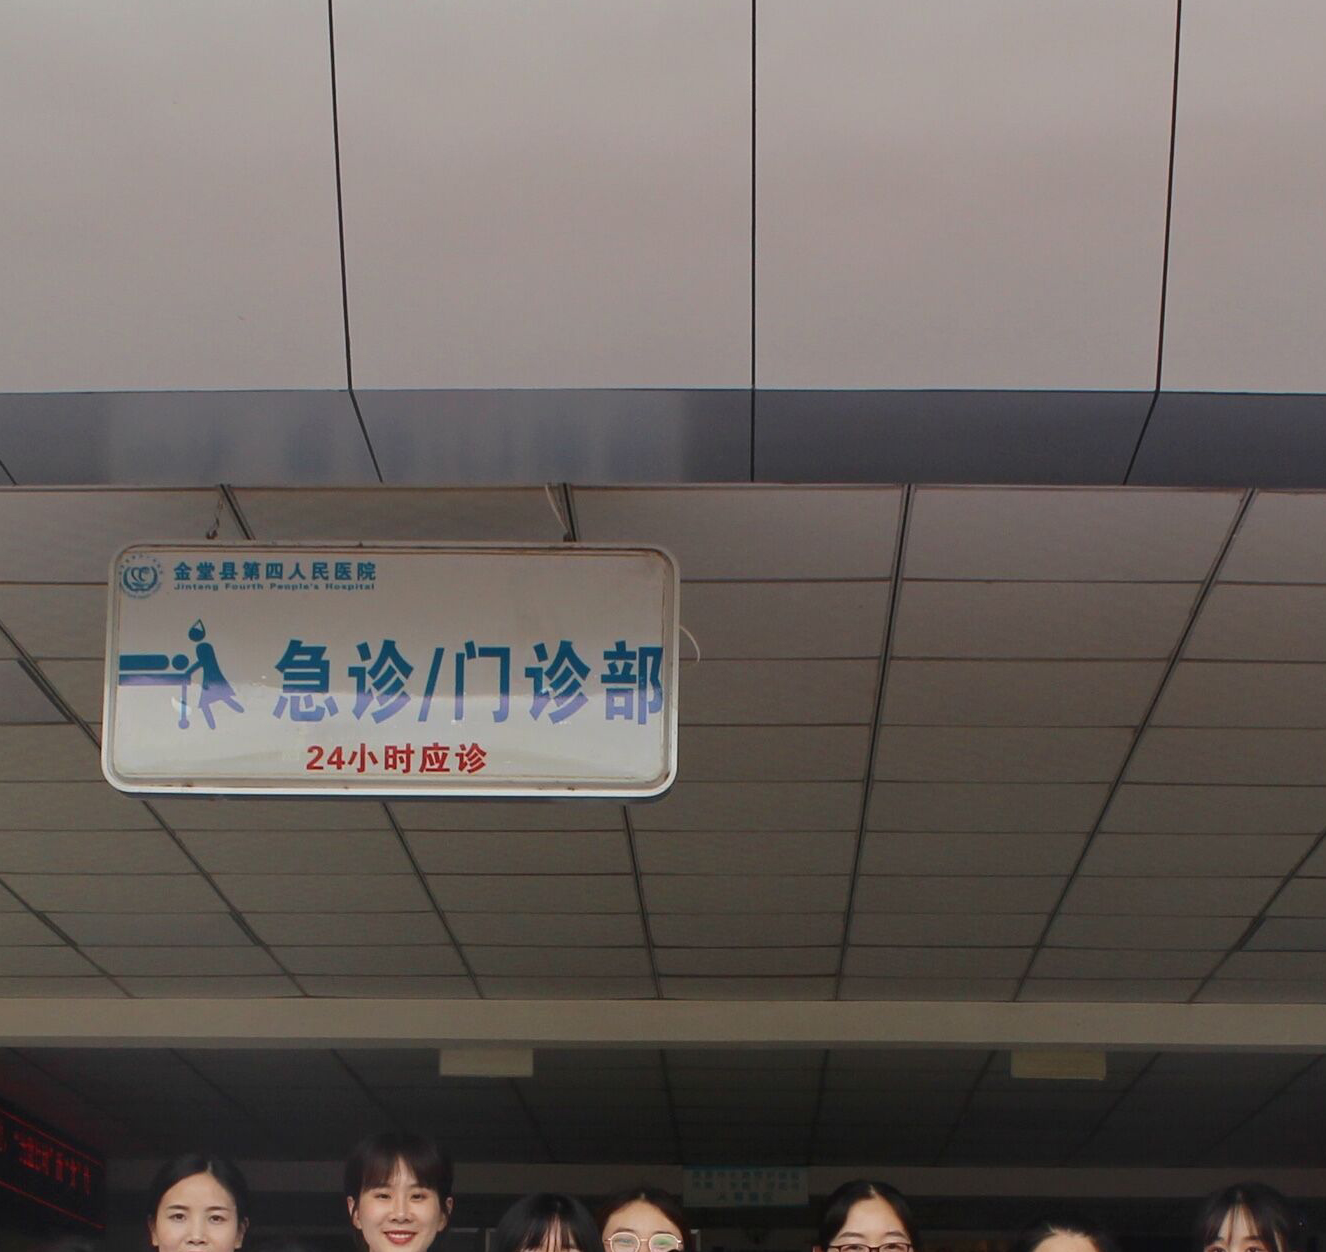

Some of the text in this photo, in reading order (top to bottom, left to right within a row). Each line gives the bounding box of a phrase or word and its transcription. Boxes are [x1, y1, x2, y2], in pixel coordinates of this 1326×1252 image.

[173, 562, 377, 582] 金堂县第四人民医院
[173, 582, 220, 592] Jintang
[225, 582, 264, 591] Fourth
[325, 582, 375, 592] Hospital
[273, 639, 664, 725] 急诊/门诊部
[306, 742, 488, 774] 24小时应诊
